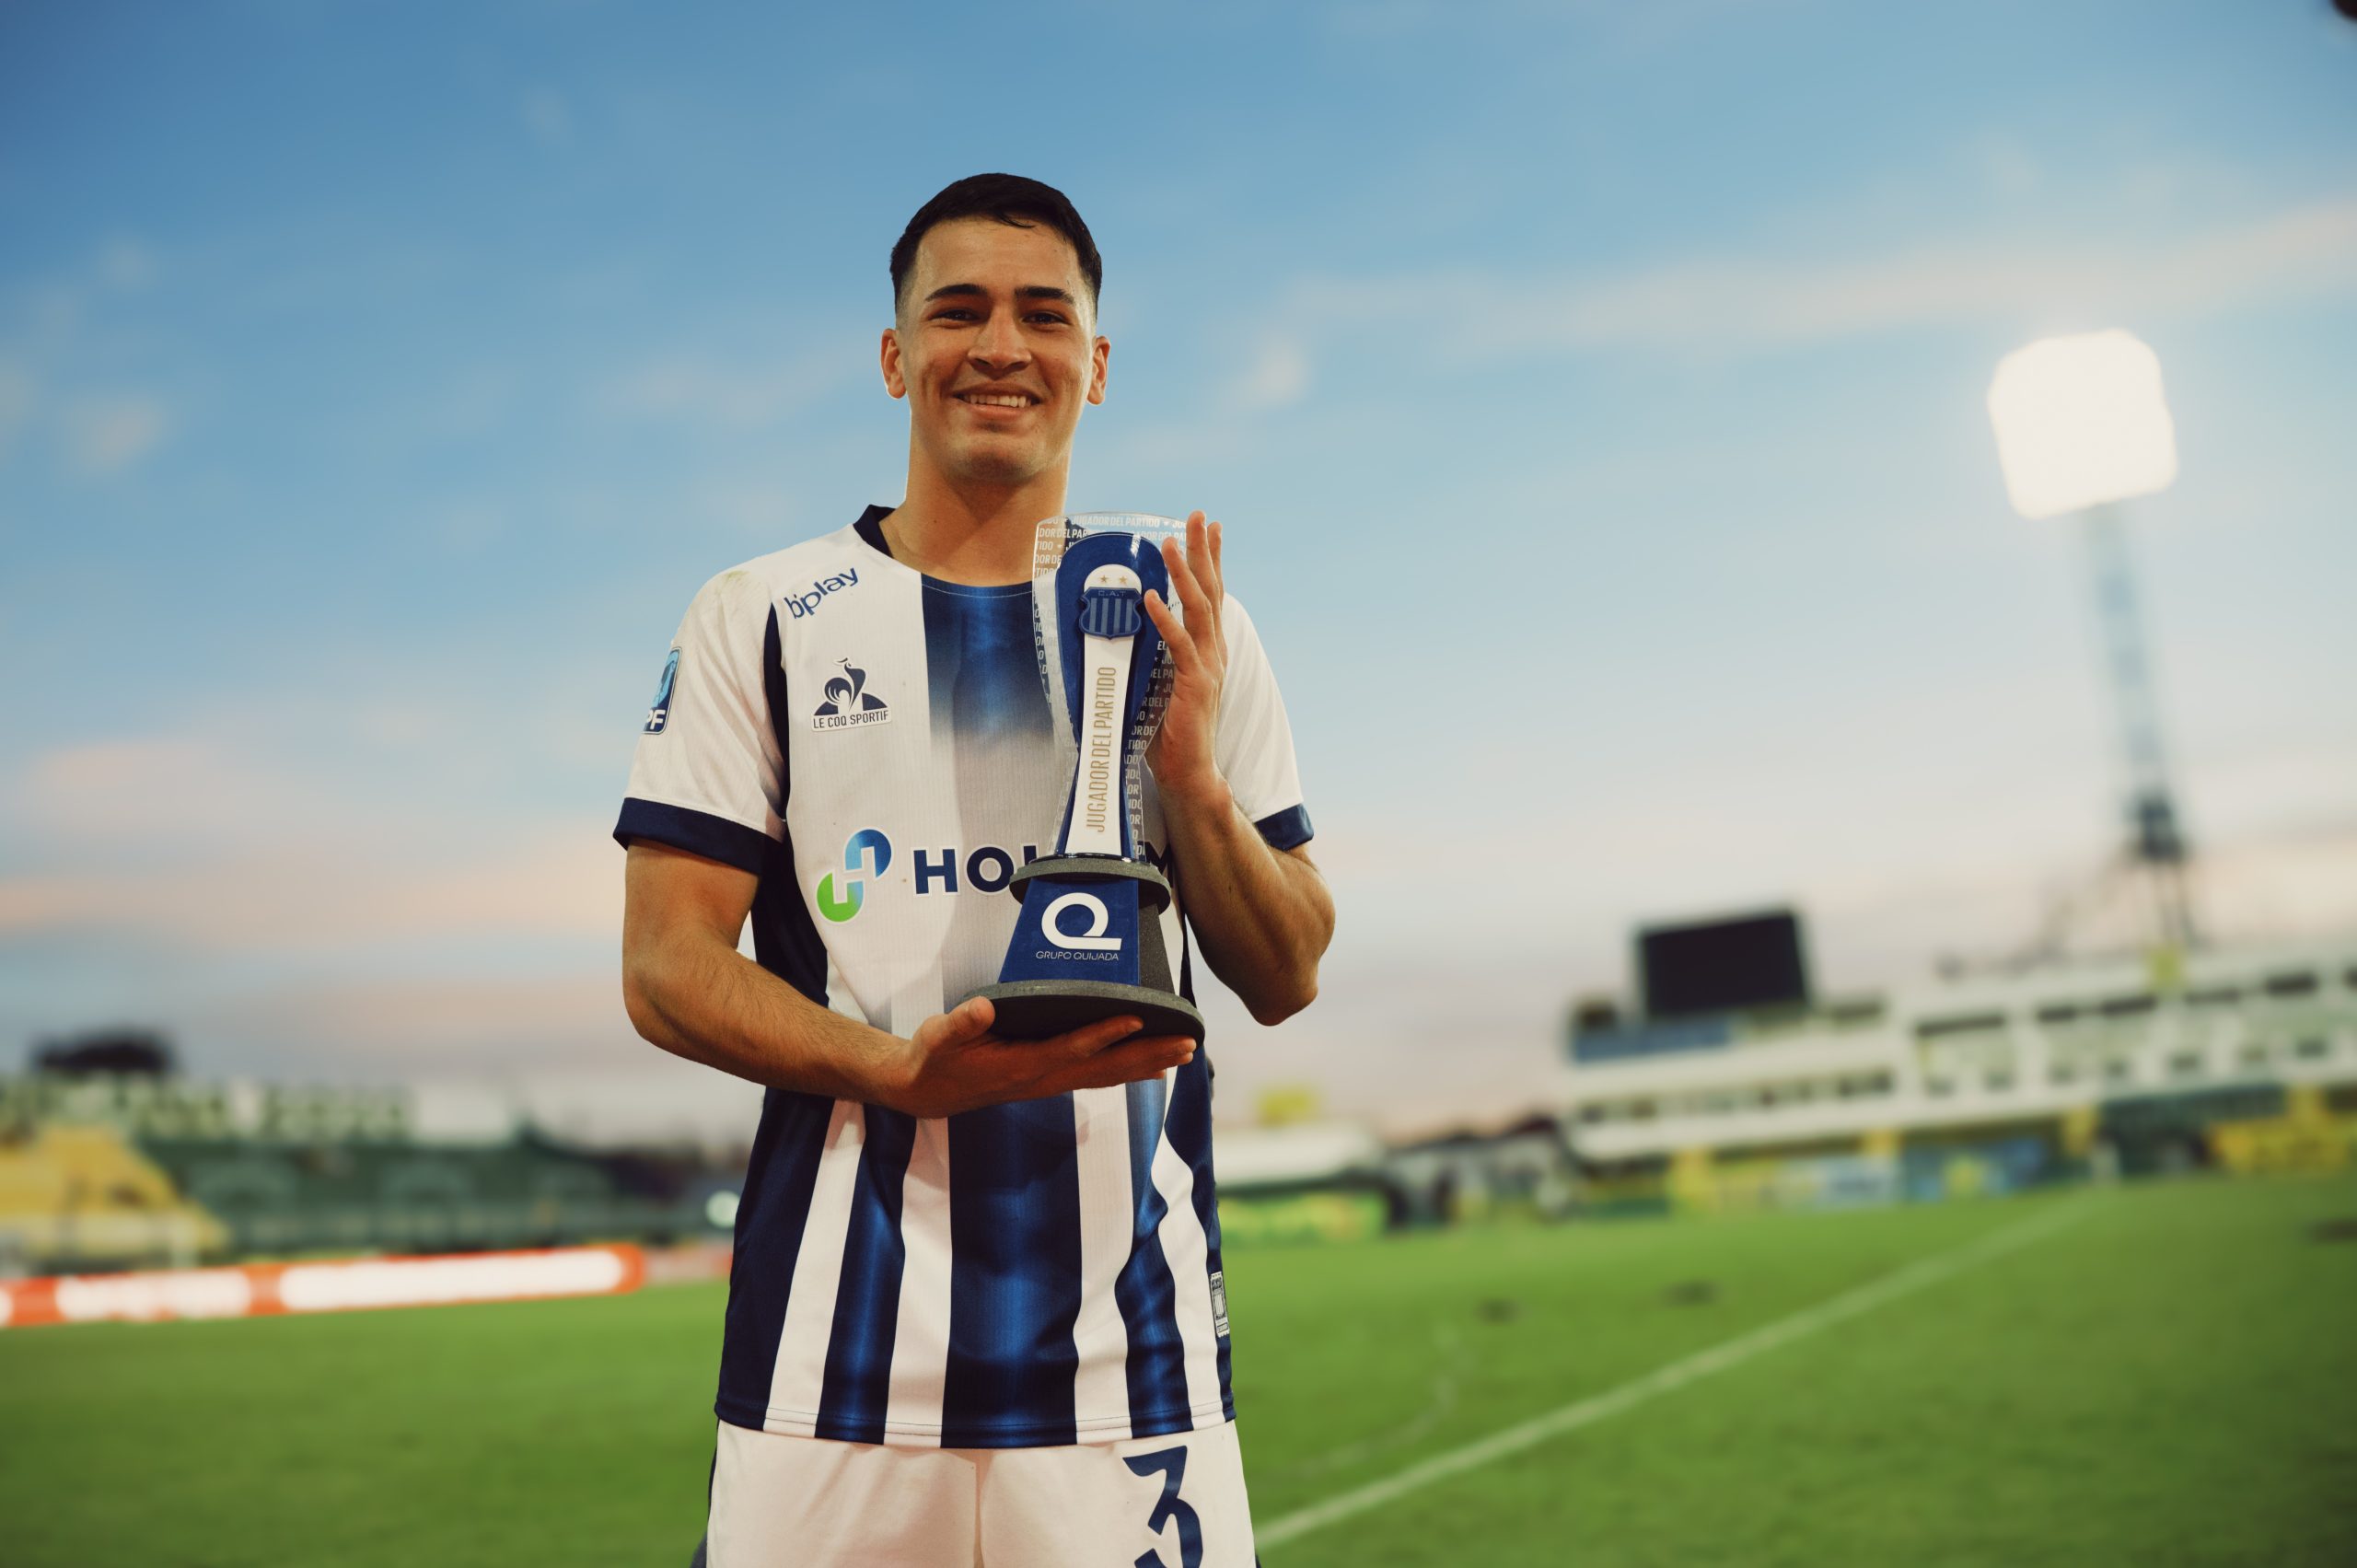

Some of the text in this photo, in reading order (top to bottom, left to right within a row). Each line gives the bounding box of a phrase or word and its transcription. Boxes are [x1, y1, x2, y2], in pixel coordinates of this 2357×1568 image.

[1110, 516, 1125, 527] DEL
[1125, 516, 1160, 528] PARTIDO
[813, 706, 888, 729] LE COQ SPORTIF
[1086, 667, 1116, 833] JUGADOR DEL PARTIDO
[1036, 951, 1120, 961] GRUPO QUIJADA
[1122, 1446, 1203, 1568] 3
